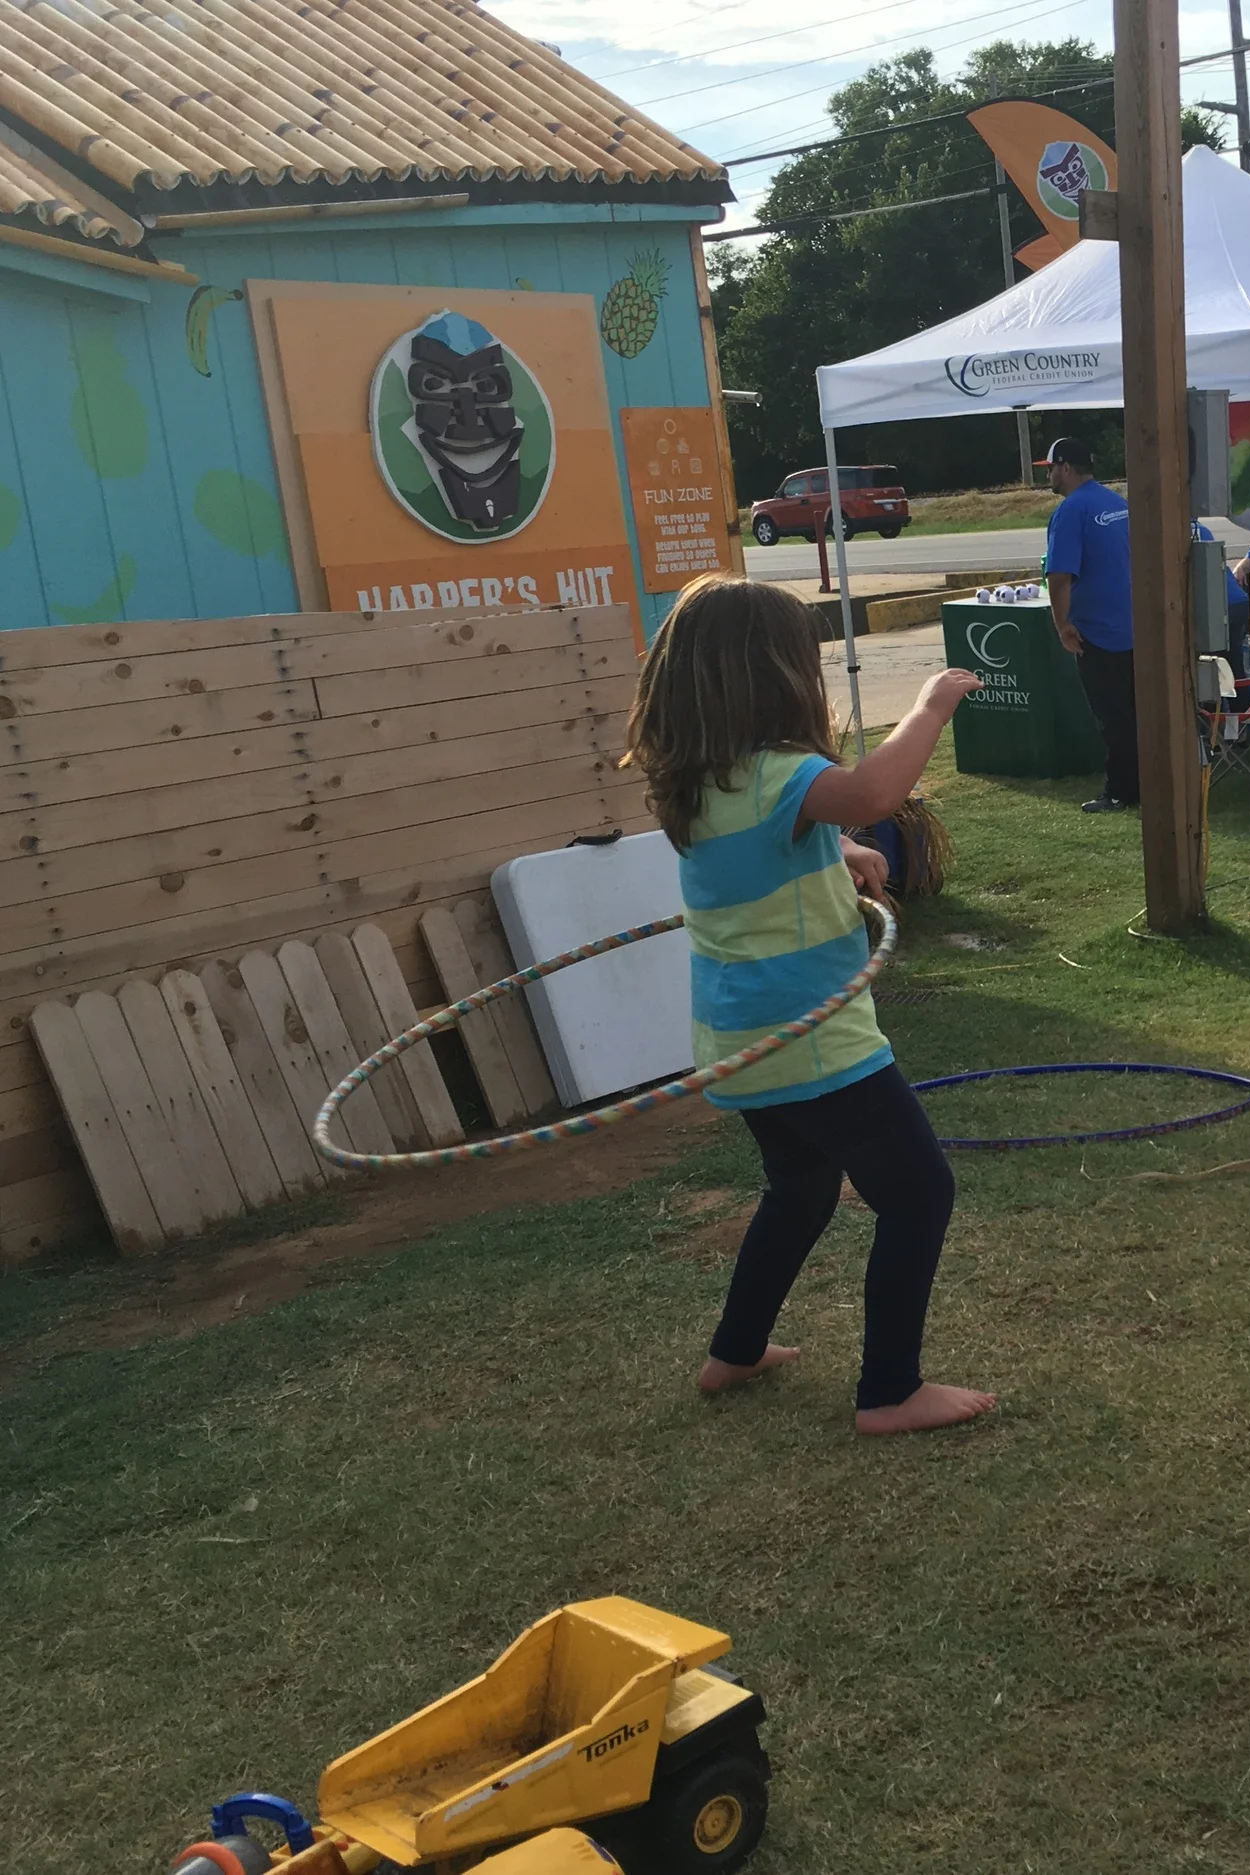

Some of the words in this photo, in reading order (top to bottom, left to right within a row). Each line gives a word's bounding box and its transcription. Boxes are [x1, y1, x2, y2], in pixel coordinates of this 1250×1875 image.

[971, 356, 1020, 377] GREEN
[1023, 352, 1100, 371] COUNTRY
[992, 374, 1026, 385] FEDERAL
[1029, 371, 1061, 381] CREDIT
[1064, 369, 1094, 379] UNION
[644, 489, 674, 504] FUN
[677, 487, 714, 502] ZONE
[356, 575, 541, 613] HARPER'S
[555, 566, 614, 607] HUT
[973, 669, 1017, 687] GREEN
[577, 1719, 650, 1763] Tonka
